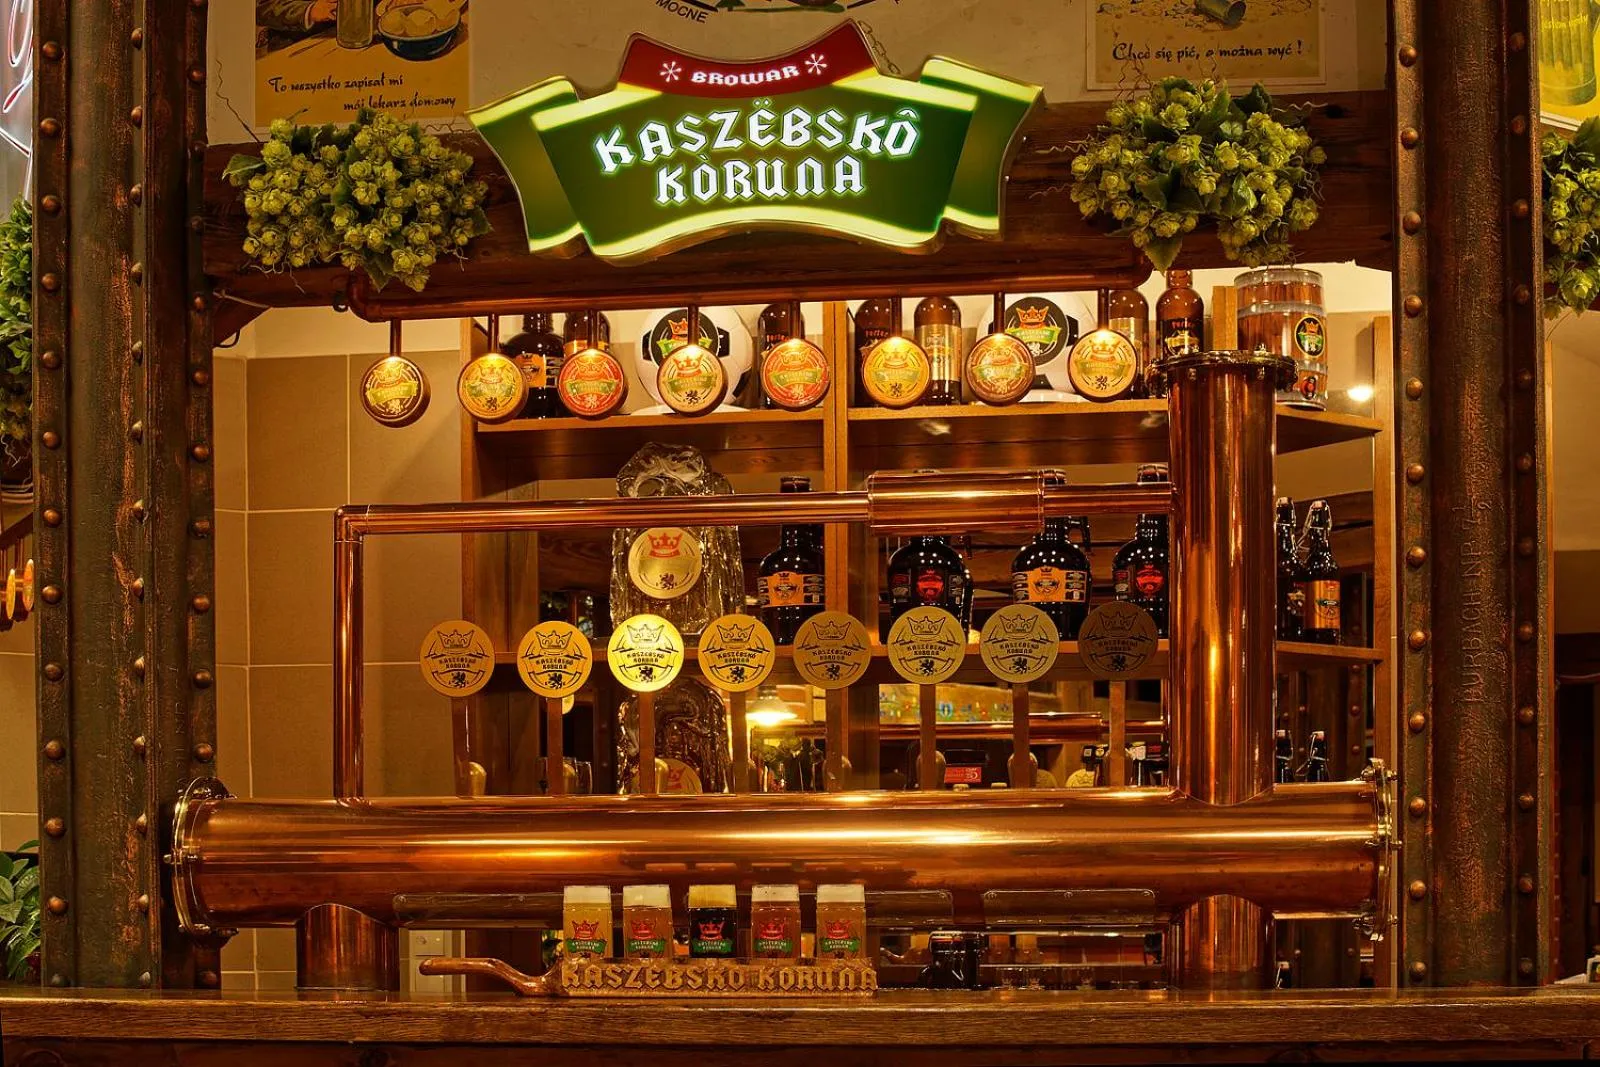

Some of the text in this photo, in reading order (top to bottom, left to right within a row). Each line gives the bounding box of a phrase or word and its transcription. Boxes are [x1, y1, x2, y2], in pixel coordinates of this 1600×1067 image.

[655, 0, 709, 24] MOCNE
[1155, 46, 1173, 62] się
[1176, 45, 1200, 63] pić,
[1219, 45, 1263, 57] można
[268, 72, 403, 94] To wszystko zapisał mi
[691, 65, 800, 86] BROWAR
[368, 95, 406, 109] lekarz
[409, 92, 456, 108] domowy
